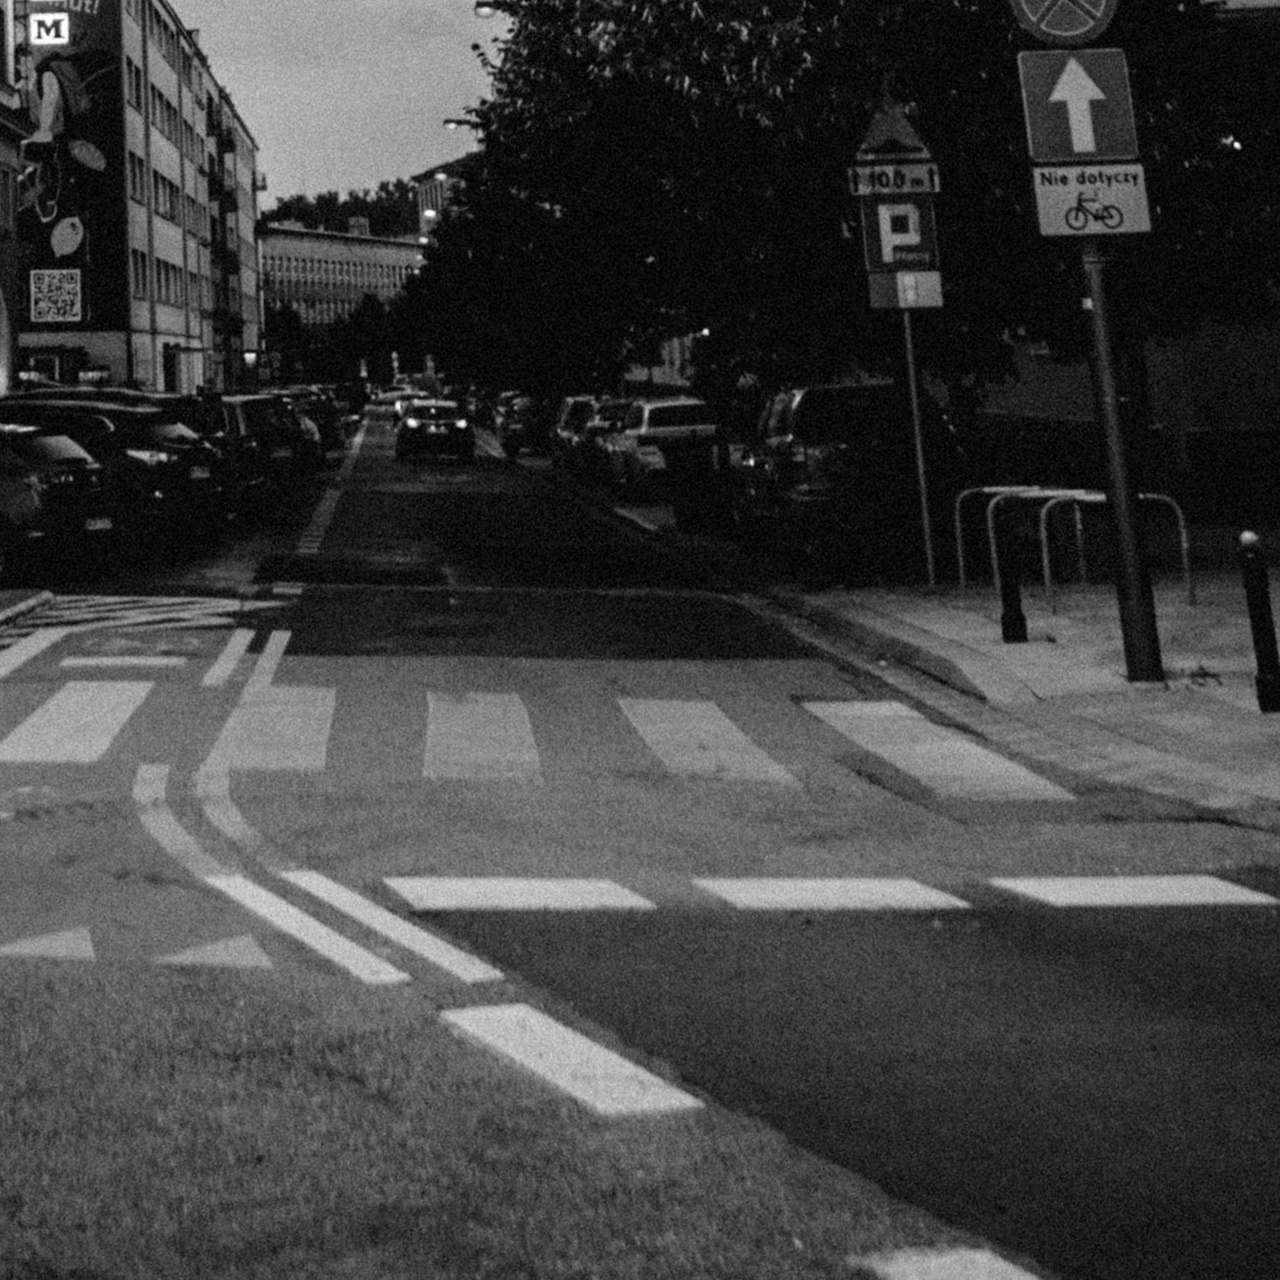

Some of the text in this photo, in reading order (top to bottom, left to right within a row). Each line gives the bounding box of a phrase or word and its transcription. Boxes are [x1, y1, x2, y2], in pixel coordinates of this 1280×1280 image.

[1040, 170, 1138, 188] Nie dotyczy
[878, 204, 921, 264] P
